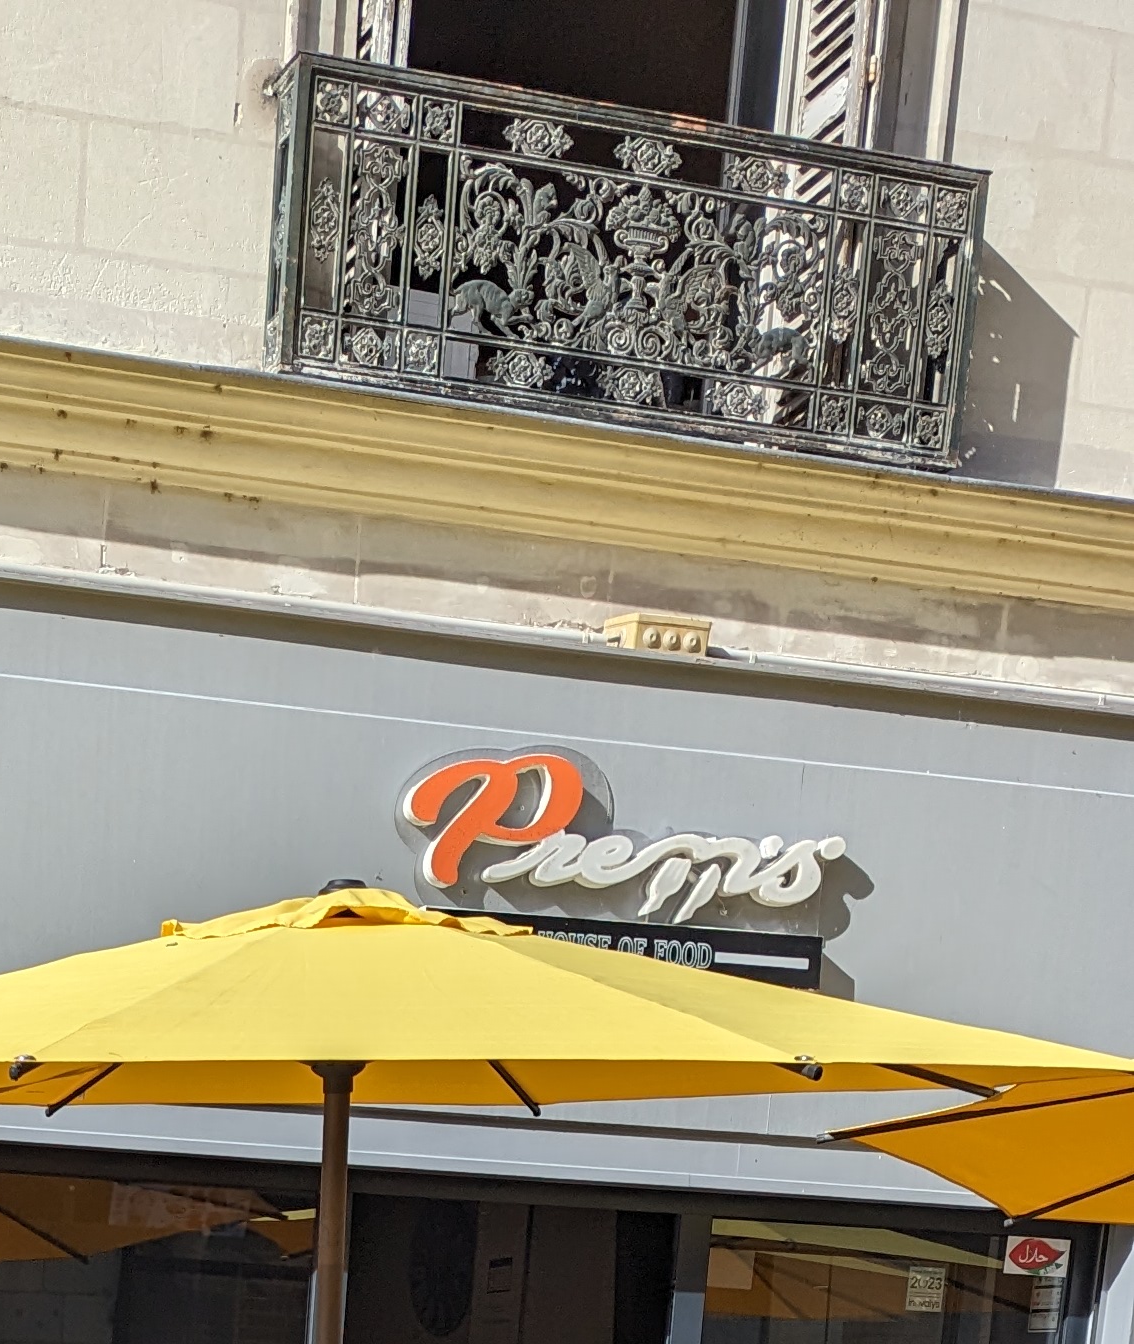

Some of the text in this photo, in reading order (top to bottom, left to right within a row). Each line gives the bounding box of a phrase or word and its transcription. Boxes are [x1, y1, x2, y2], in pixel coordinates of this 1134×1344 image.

[403, 753, 847, 924] Prem's
[654, 939, 713, 969] FOOD
[910, 1276, 943, 1290] 2023
